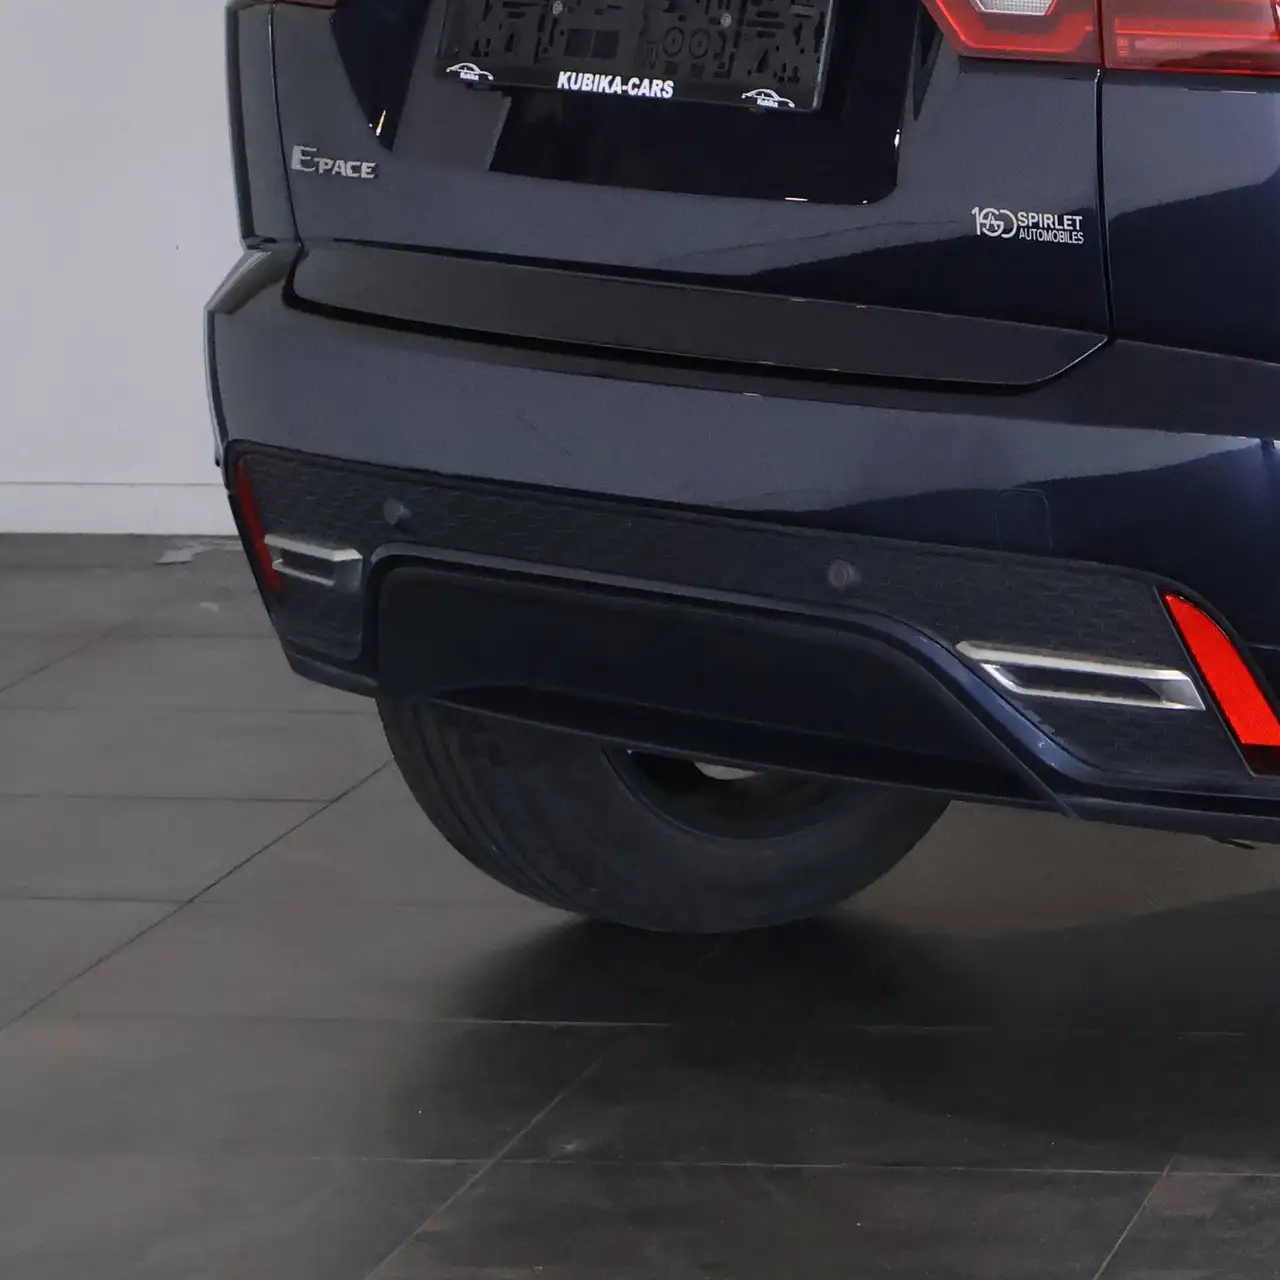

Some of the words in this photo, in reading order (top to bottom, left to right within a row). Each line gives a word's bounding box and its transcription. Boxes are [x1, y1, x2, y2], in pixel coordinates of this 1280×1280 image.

[557, 71, 674, 98] KUBIKA-CARS
[1017, 212, 1083, 230] SPIRLET
[1019, 228, 1085, 244] AUTOMOBILES
